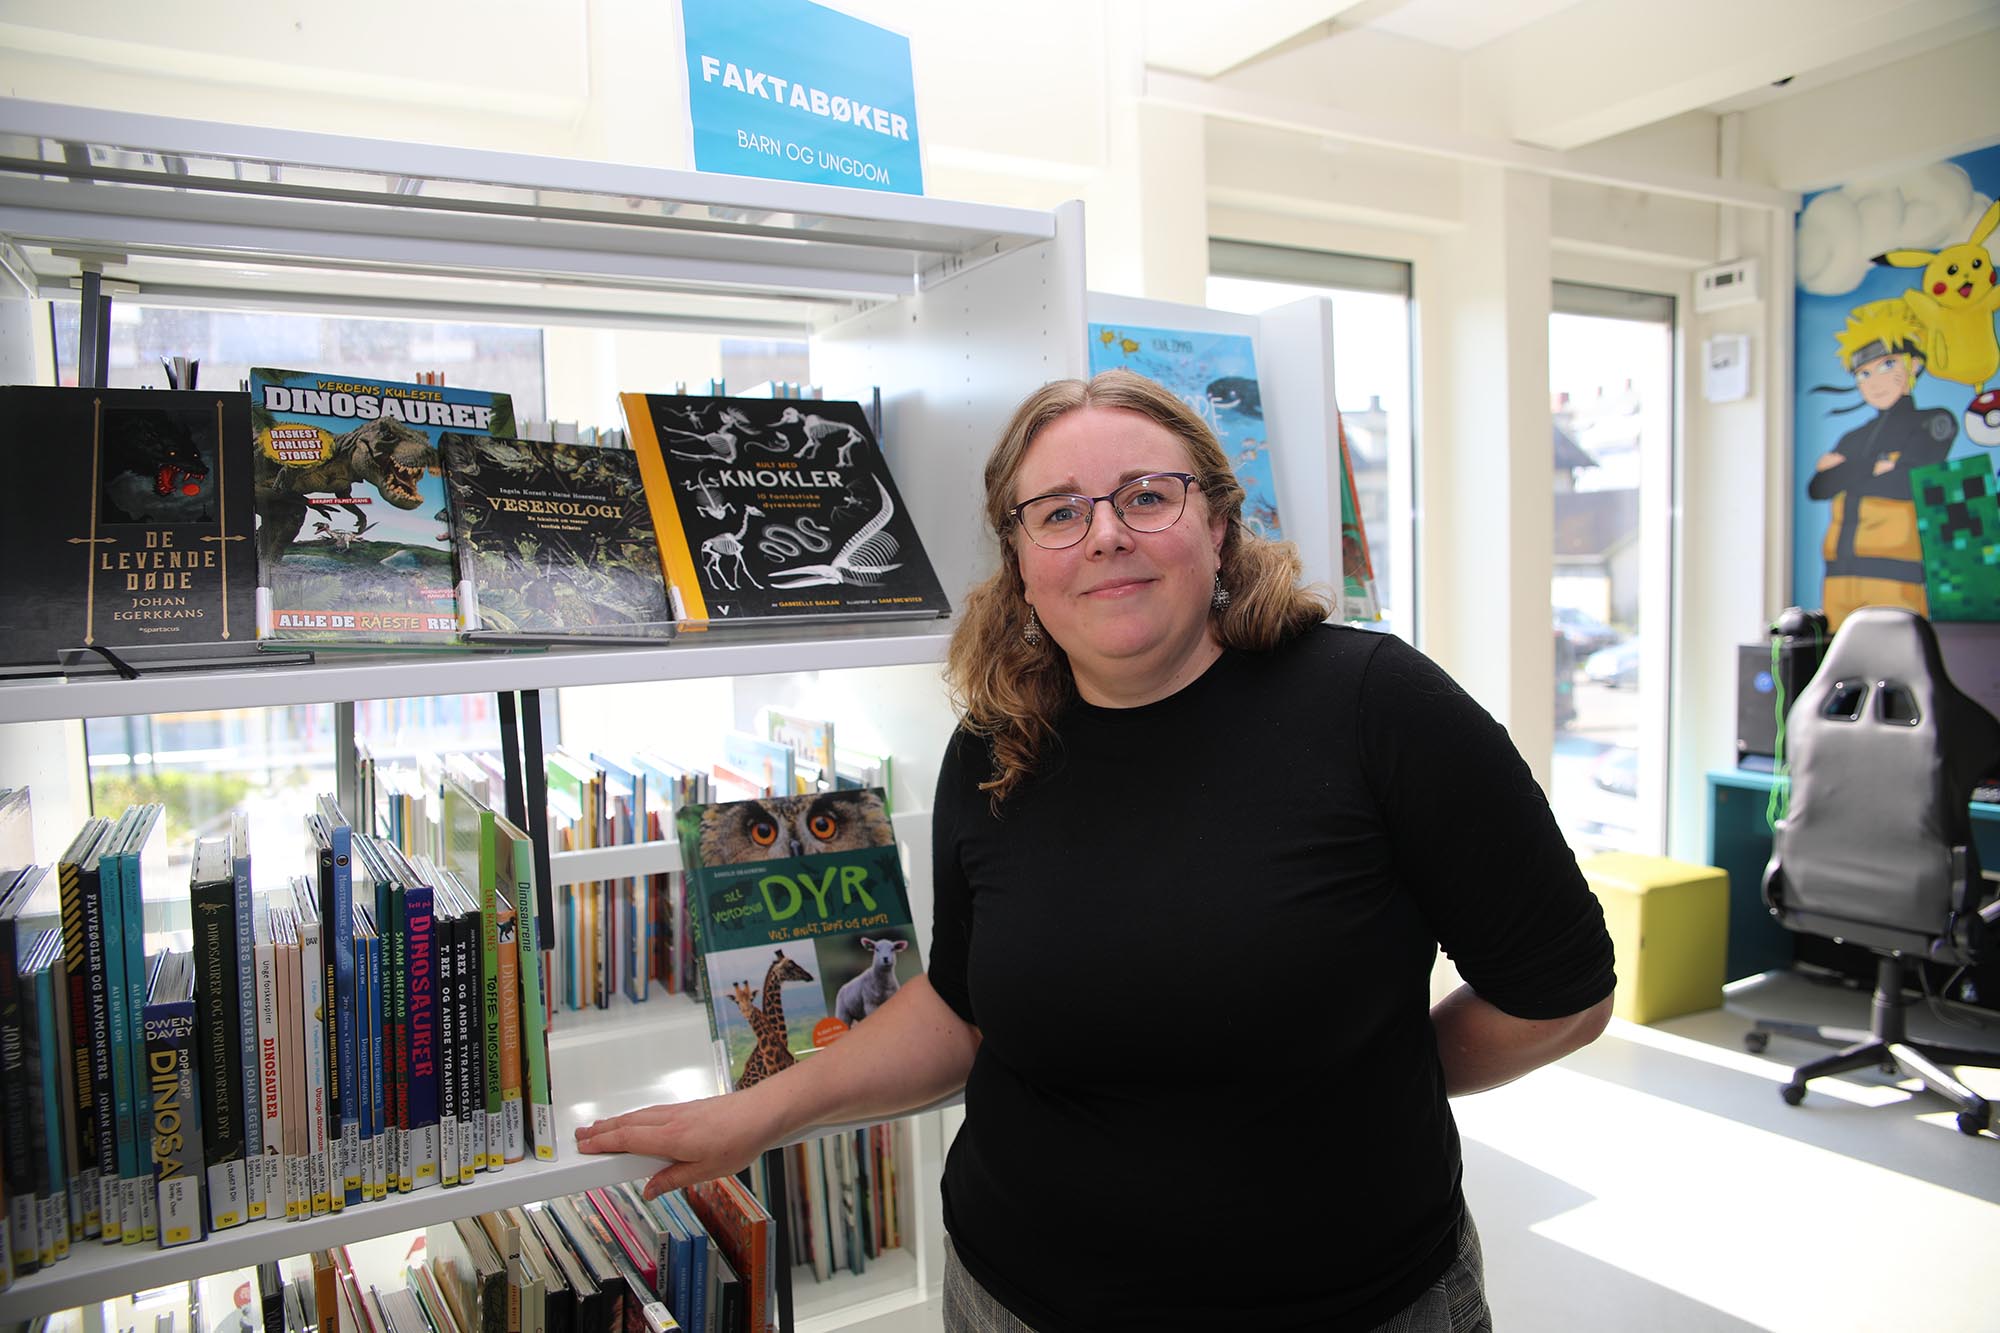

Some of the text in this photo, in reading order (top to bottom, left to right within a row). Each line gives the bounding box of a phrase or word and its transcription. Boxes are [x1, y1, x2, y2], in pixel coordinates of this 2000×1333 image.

[701, 55, 909, 141] FAKTABØKER
[737, 129, 890, 185] BARN OG UNGDOM
[317, 380, 442, 401] VERDENS KULESTE
[270, 429, 318, 440] RASKEST
[271, 439, 323, 450] FARLIGST
[279, 450, 321, 461] STØRST
[719, 469, 844, 488] KNOKLER
[486, 496, 623, 519] VESENOLOGI
[145, 531, 174, 548] DE
[101, 550, 216, 570] LEVENDE
[126, 571, 193, 591] DØDE
[113, 609, 205, 621] EGERKRANS
[132, 597, 186, 609] JOHAN
[279, 614, 328, 628] ALLE
[331, 615, 355, 628] DE
[778, 600, 813, 608] GABRIELLE
[484, 889, 495, 908] LINE
[758, 866, 878, 921] DYR
[517, 882, 532, 952] Dinosaurene
[844, 918, 860, 929] OG
[238, 875, 255, 1053] ALLE TIDERS DINOSAURER
[382, 932, 392, 1018] SARAH SHEPPARD
[395, 931, 406, 1018] SARAH SHEPPARD
[86, 894, 109, 1080] FLYVEØGLER OG HAVMONSTRE
[261, 960, 274, 1025] Unge forskerspirer
[409, 914, 434, 1078] DINOSAURER
[442, 987, 451, 1003] OG
[458, 983, 467, 1000] OG
[144, 1016, 193, 1031] OWEN
[459, 1003, 469, 1042] ANDRE
[501, 963, 515, 1050] DINOSAURER
[146, 1025, 193, 1042] DAVEY
[206, 923, 230, 1139] DINOSAURER OG FORHISTORISKE DYR
[442, 1007, 452, 1046] ANDRE
[486, 975, 499, 1094] TØFFE DINOSAURER
[1, 1024, 22, 1071] JORDA
[472, 1041, 481, 1059] SLIK
[75, 1047, 92, 1109] REKORDBOK
[178, 1048, 193, 1099] POPP-OPP
[245, 1064, 257, 1105] JOHAN
[263, 1037, 279, 1120] DINOSAURER
[444, 1048, 455, 1115] TYRANNOSA
[460, 1044, 472, 1123] TYRANNOSAU
[473, 1061, 482, 1088] LEVDE
[98, 1092, 112, 1128] JOHAN
[150, 1050, 184, 1181] DINOSA
[315, 1087, 324, 1115] Utrolige
[473, 1098, 482, 1111] RE
[230, 1191, 238, 1203] Din
[658, 1243, 667, 1290] Marc Martin
